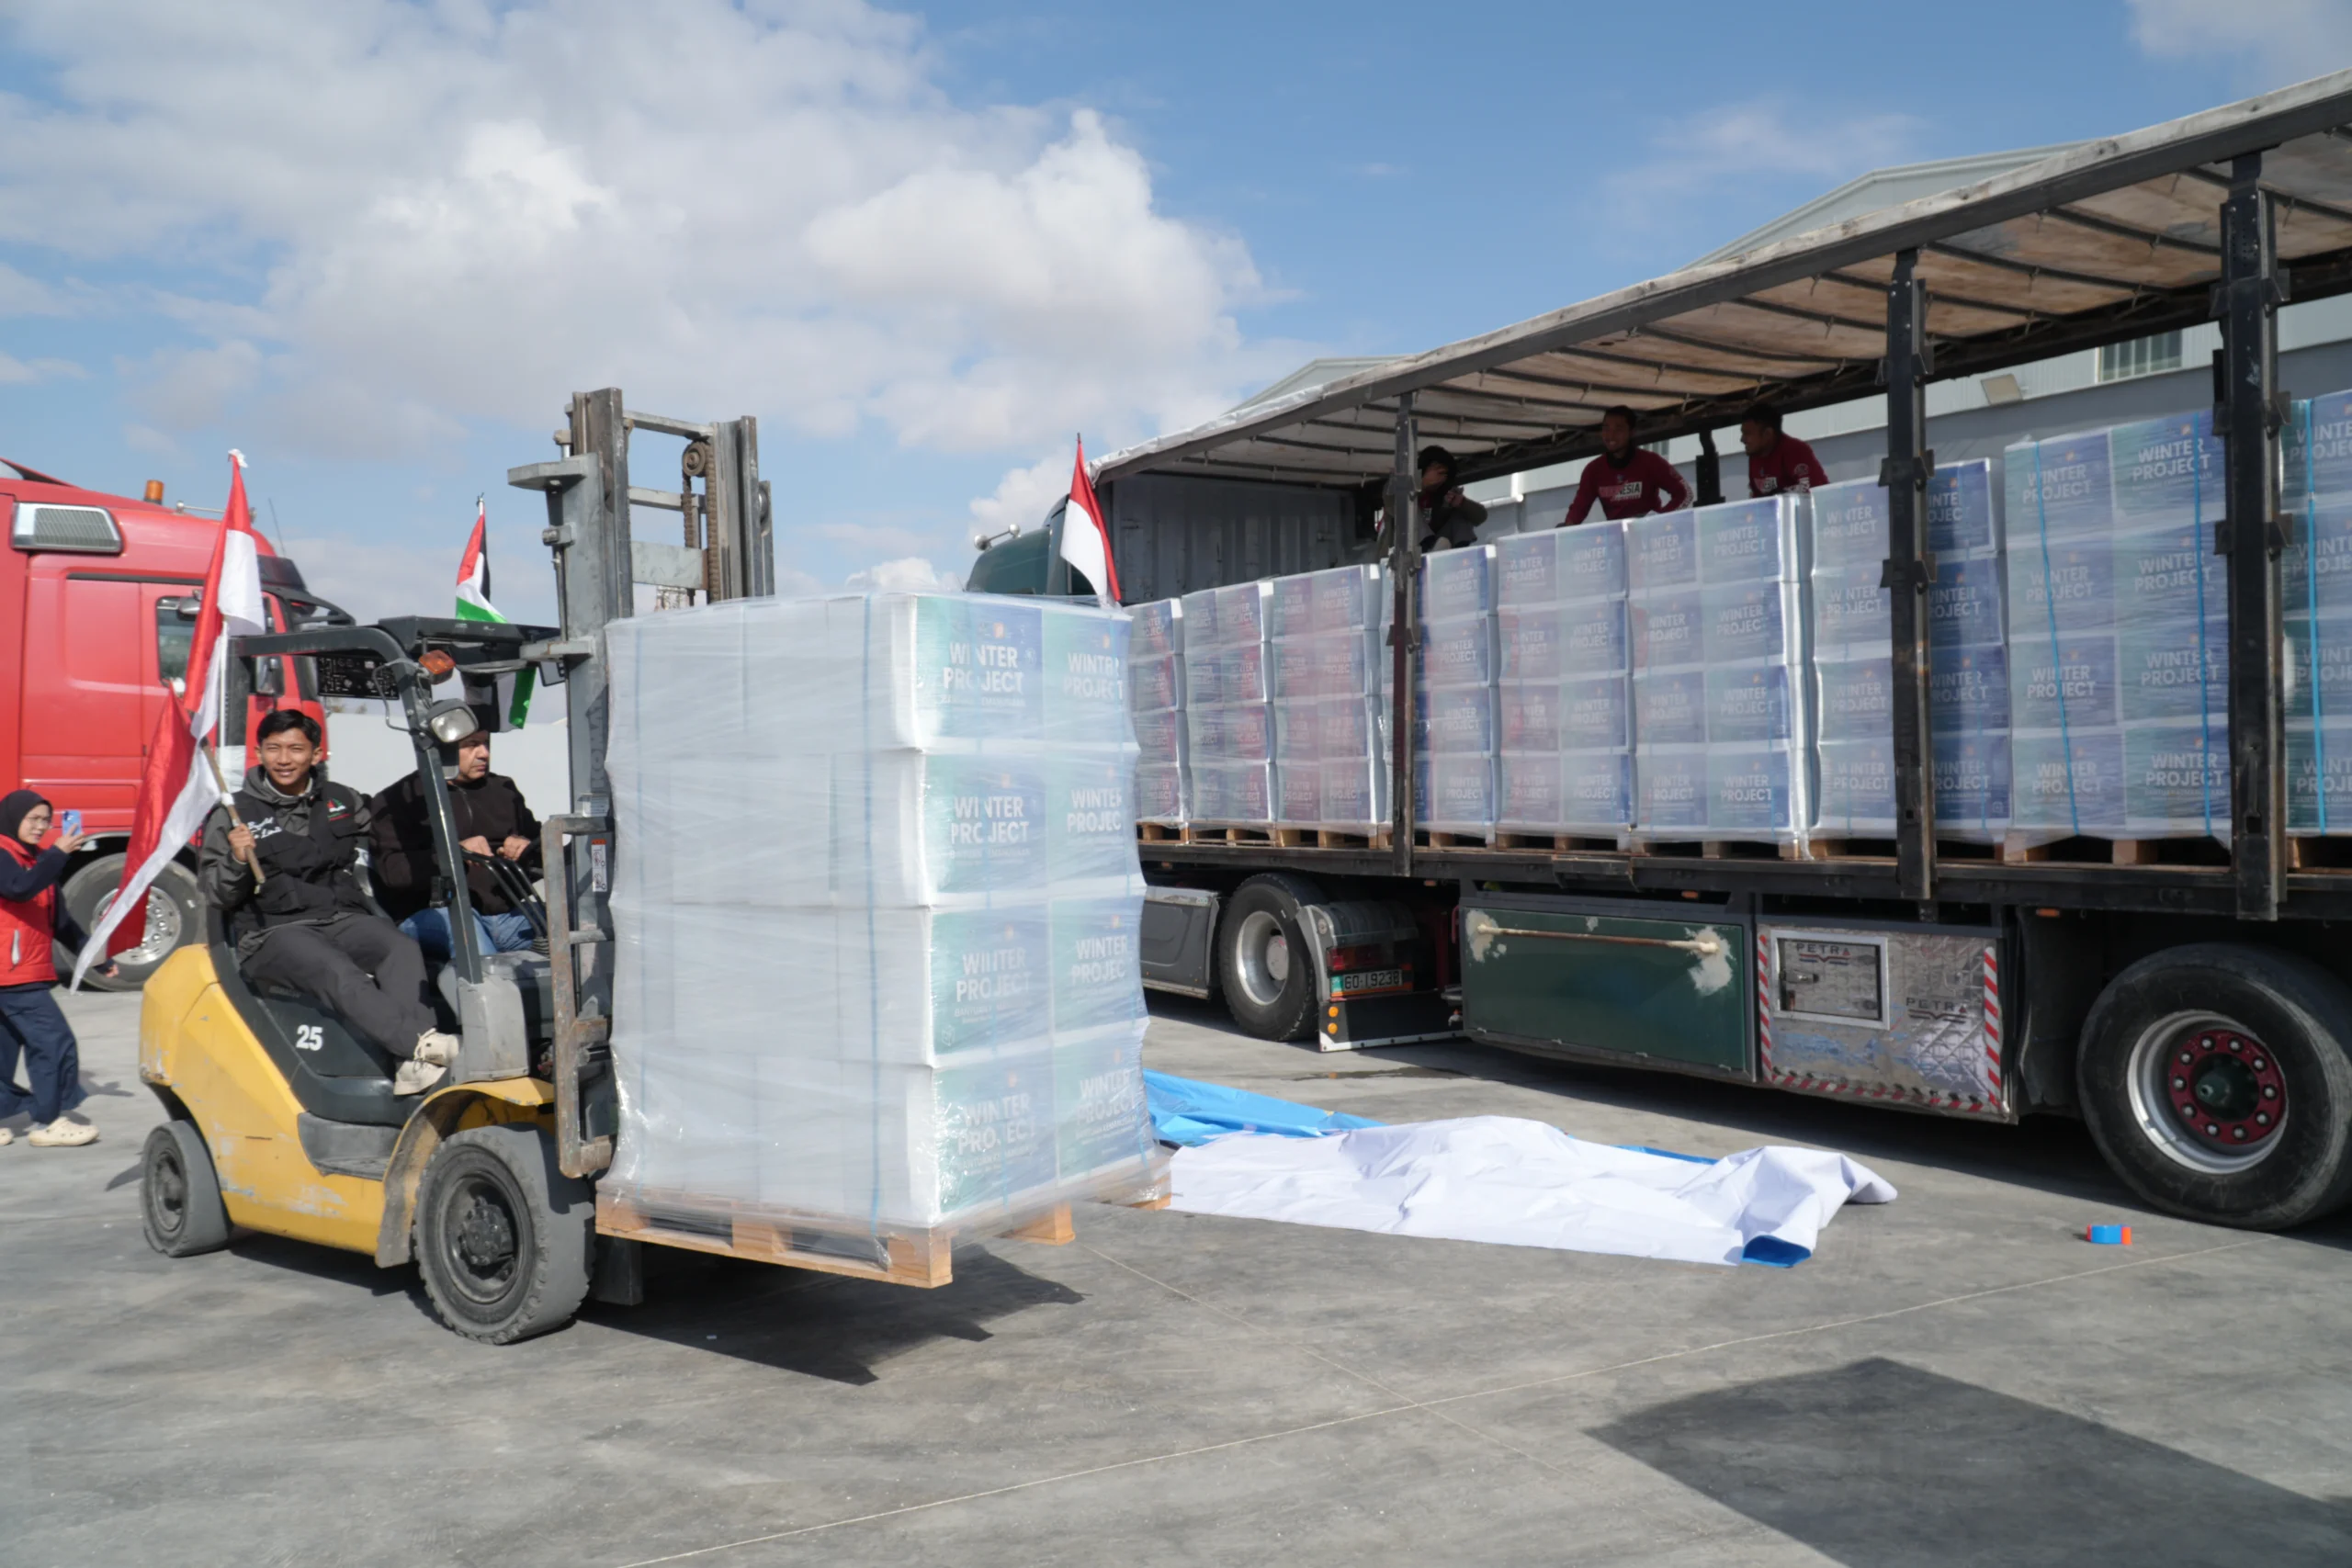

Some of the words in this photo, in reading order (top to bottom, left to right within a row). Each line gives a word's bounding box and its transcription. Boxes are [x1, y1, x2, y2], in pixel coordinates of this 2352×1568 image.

[2137, 437, 2204, 464] WINTER
[1718, 604, 1764, 622] WINTER
[1720, 700, 1775, 716] PROJECT
[2151, 752, 2220, 770] WINTER
[1724, 773, 1770, 787] WINTER
[1935, 775, 1992, 791] ROJECT
[1720, 787, 1773, 801] PROJECT
[1067, 810, 1122, 834] PROJEC
[1076, 934, 1129, 960] WINTER
[1070, 957, 1130, 986] PROJEC
[956, 971, 1034, 1003] PROJECT
[296, 1024, 324, 1052] 25
[963, 1092, 1031, 1128] WINTER
